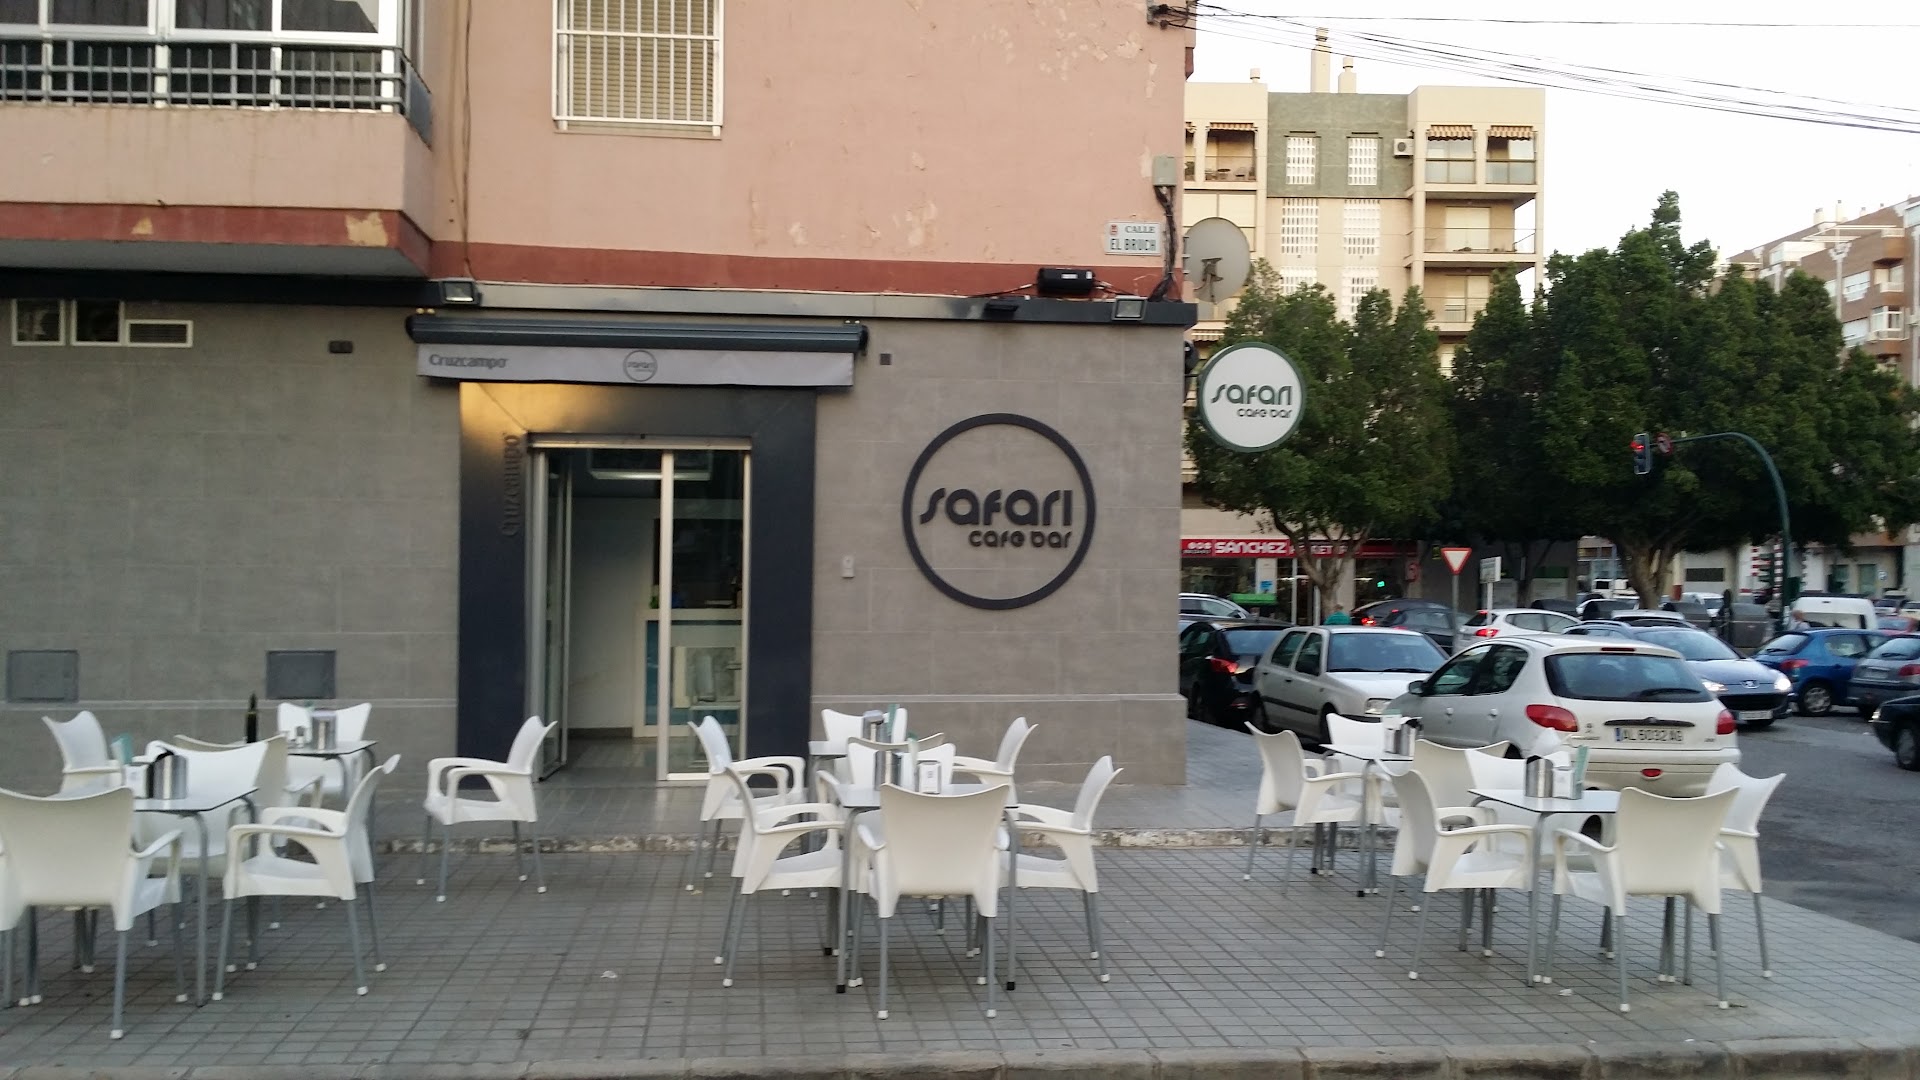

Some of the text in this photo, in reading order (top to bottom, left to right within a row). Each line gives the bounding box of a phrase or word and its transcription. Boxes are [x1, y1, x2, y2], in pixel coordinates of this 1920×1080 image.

[1125, 225, 1156, 234] CALLE
[1110, 238, 1122, 251] EL
[429, 354, 509, 370] Cruzcampo
[1211, 384, 1293, 406] safari
[1237, 408, 1293, 419] cafe bar
[919, 487, 1073, 527] safari
[969, 530, 1073, 549] cafe bar
[1214, 539, 1288, 555] SÁNCHEZ
